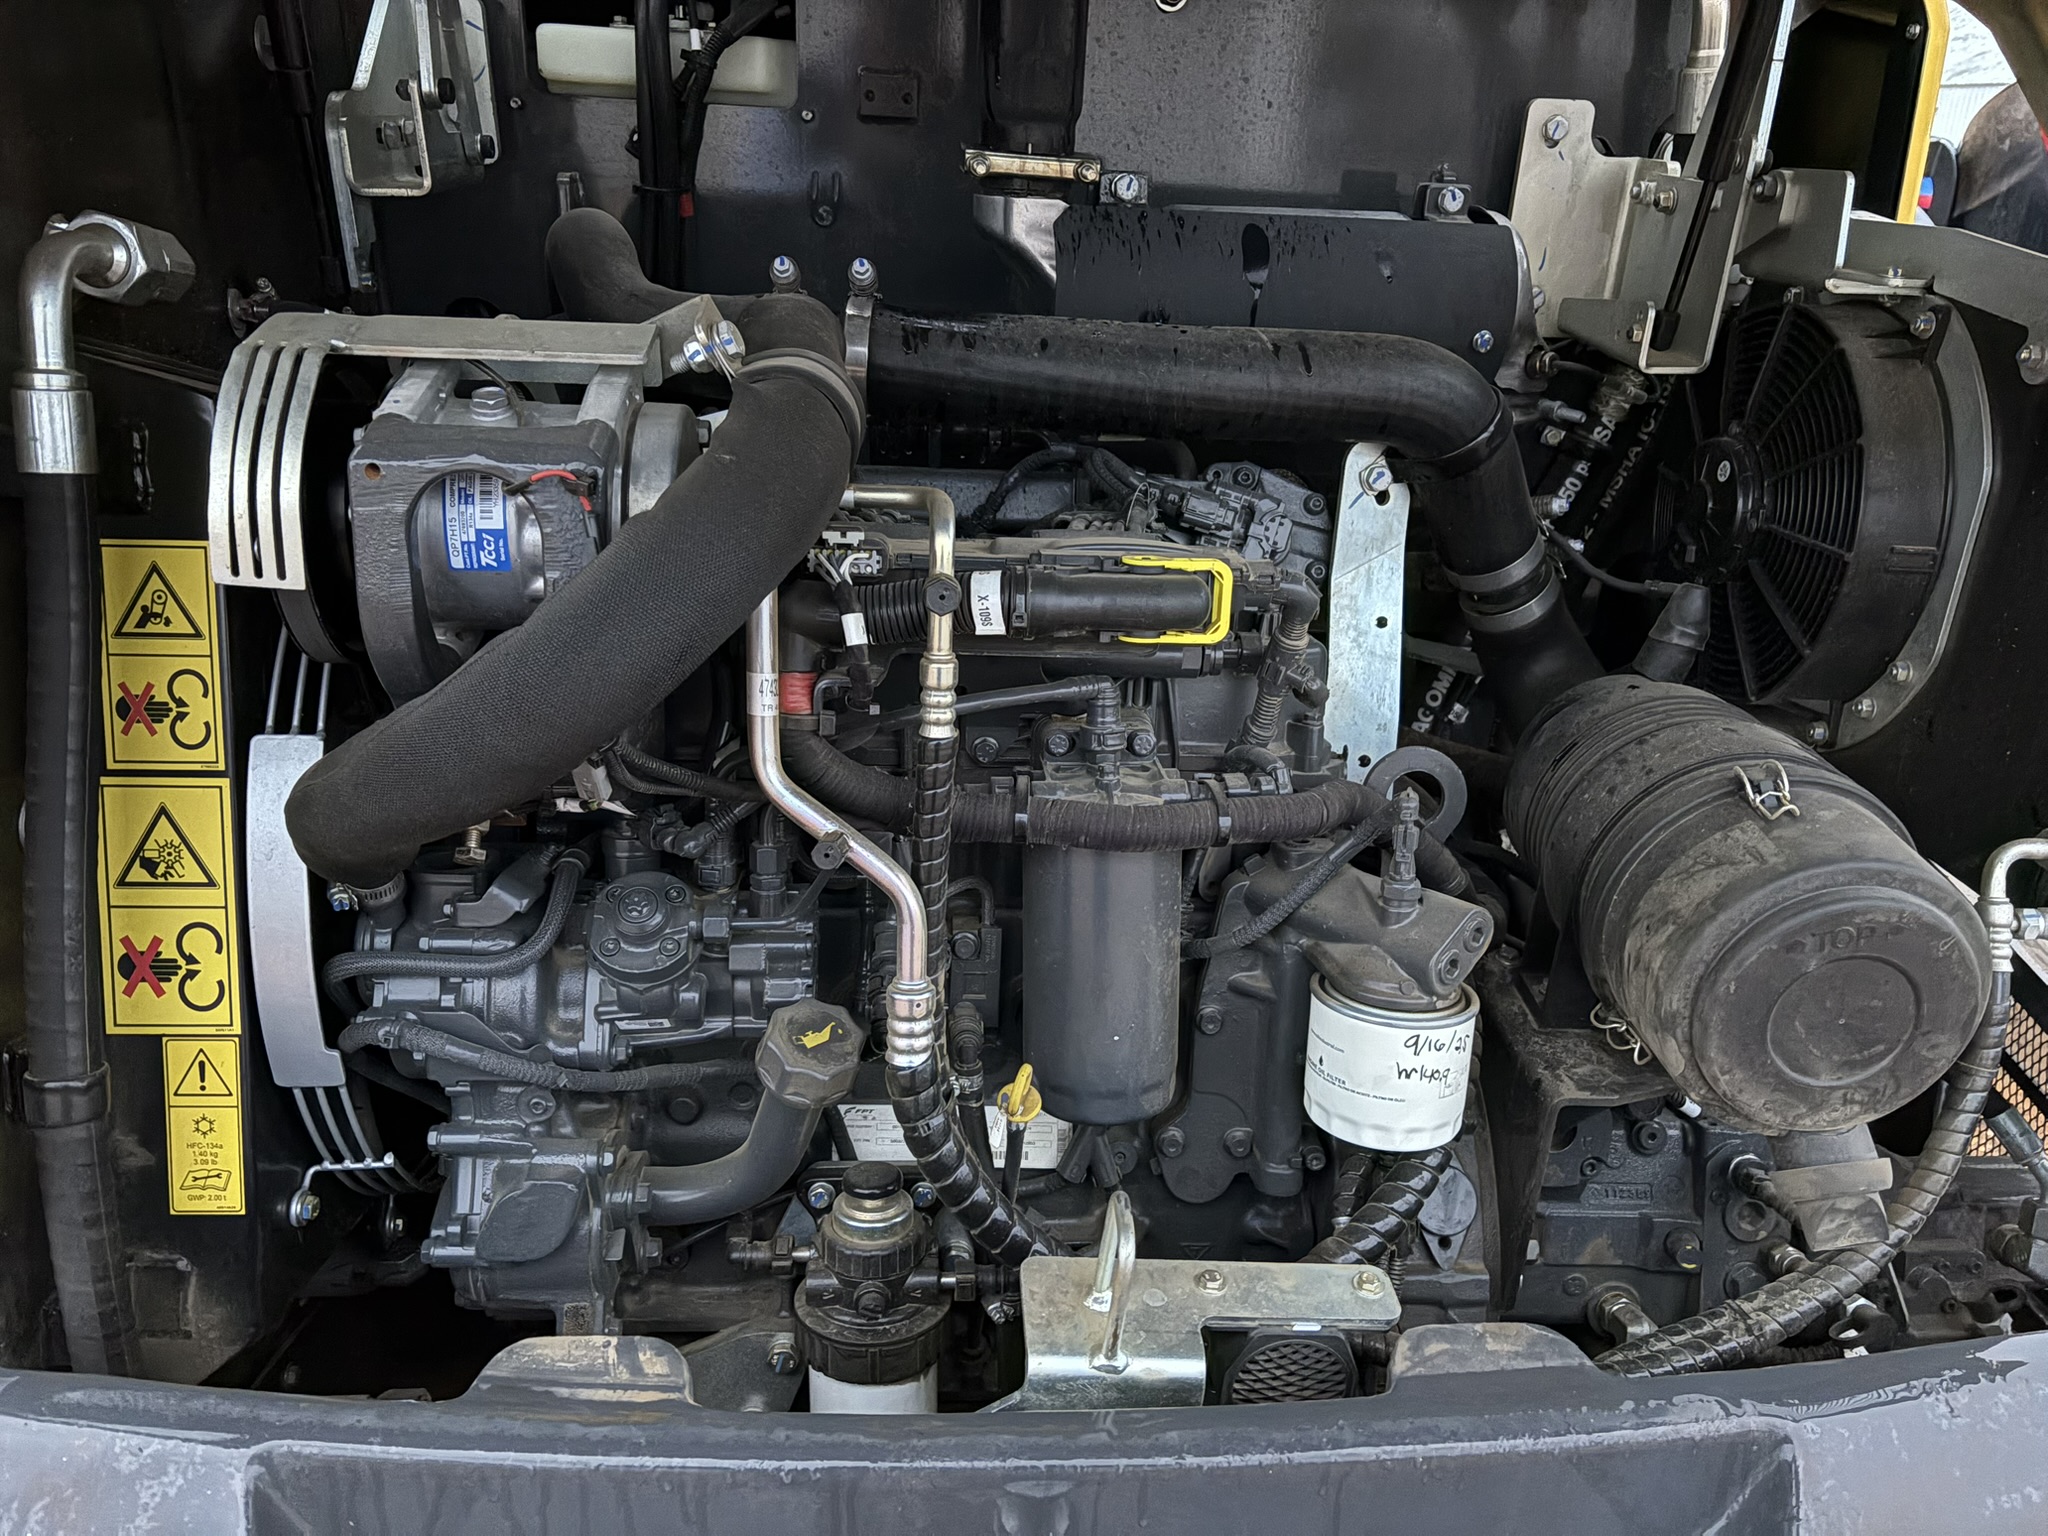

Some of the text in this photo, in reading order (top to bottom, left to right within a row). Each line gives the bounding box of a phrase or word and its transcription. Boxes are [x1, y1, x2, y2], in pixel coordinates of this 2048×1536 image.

[449, 517, 460, 557] QP7H15
[977, 594, 994, 627] X-109S
[761, 703, 774, 712] TR
[1811, 924, 1877, 953] TOP
[1327, 1072, 1346, 1086] FILTER
